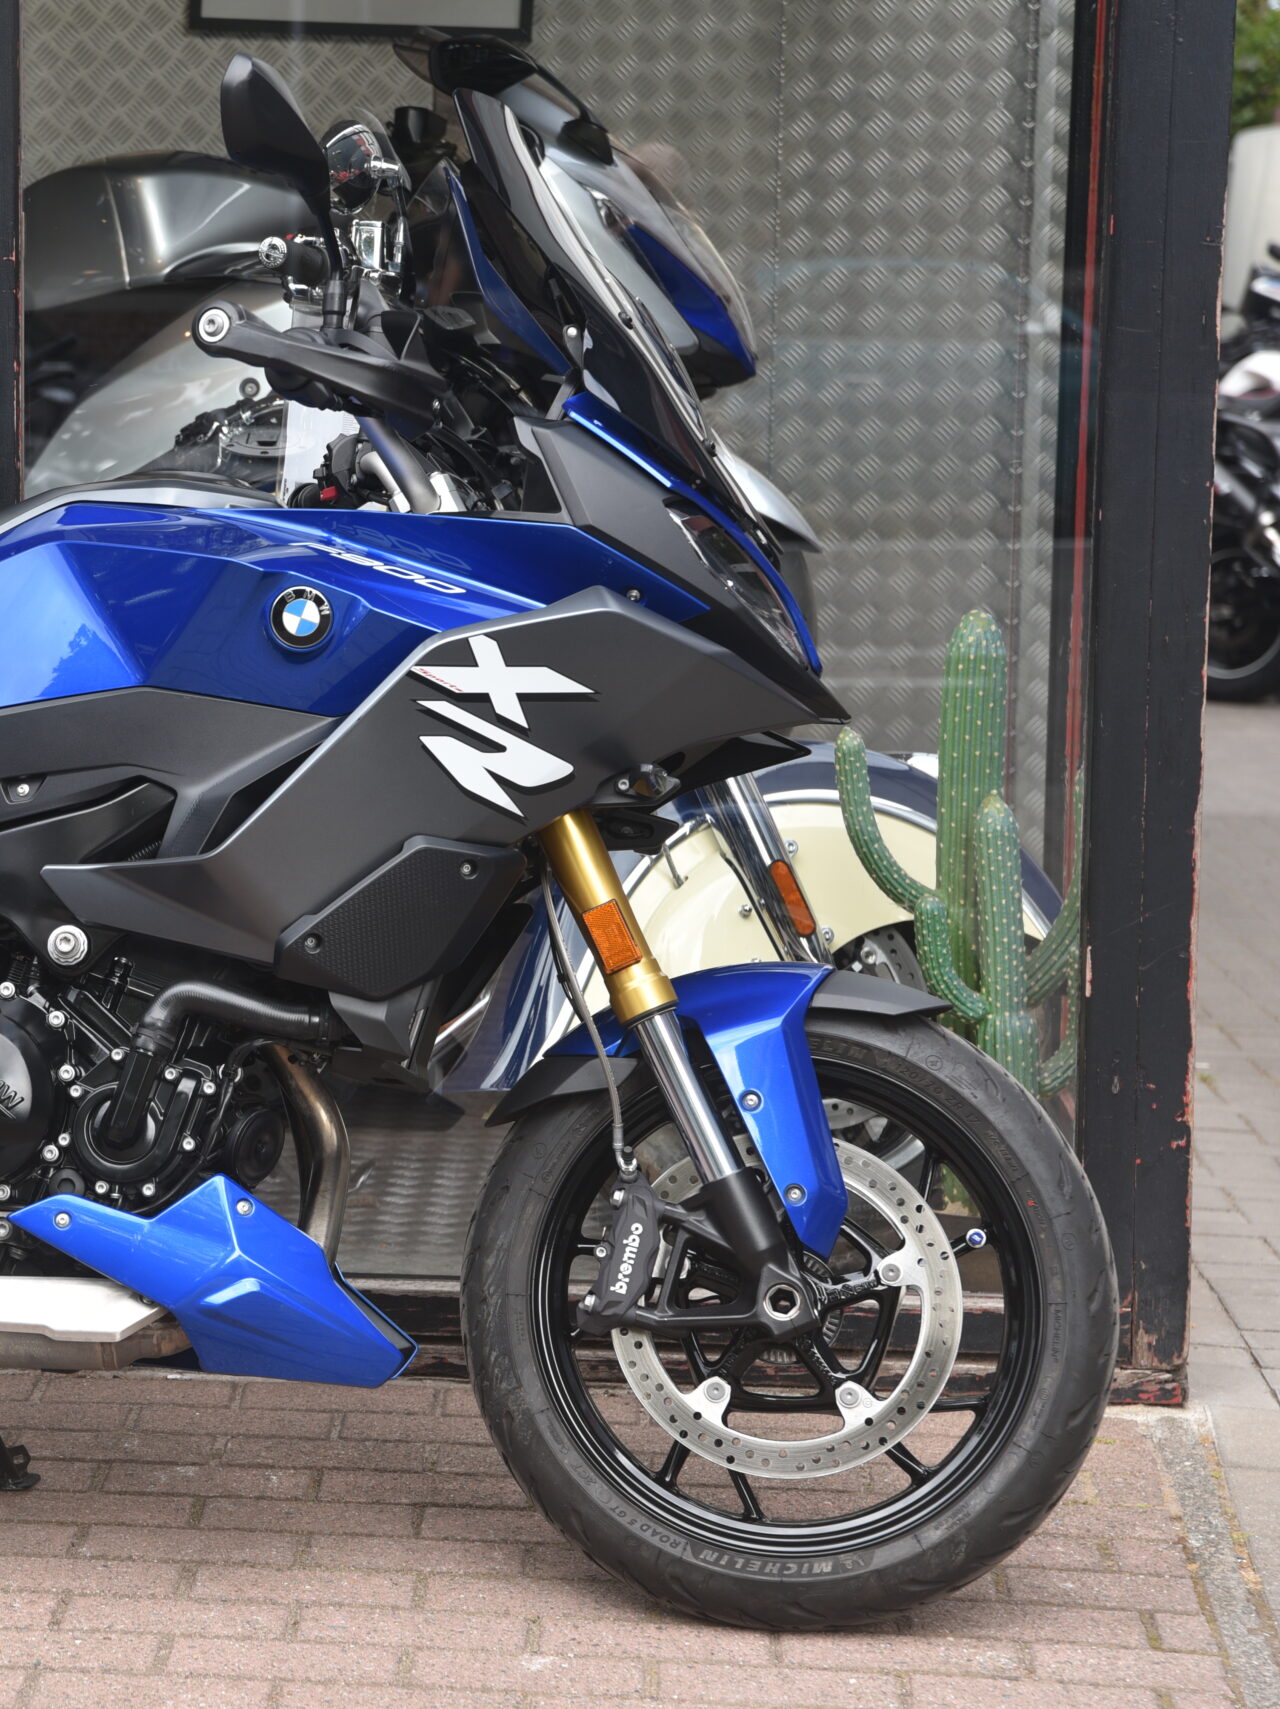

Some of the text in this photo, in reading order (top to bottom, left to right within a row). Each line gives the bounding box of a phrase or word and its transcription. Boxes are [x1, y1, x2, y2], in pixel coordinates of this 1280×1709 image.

[283, 588, 331, 615] BMW
[610, 1222, 643, 1295] brembo
[609, 1504, 627, 1518] GT
[639, 1522, 681, 1549] ROAD
[699, 1549, 833, 1575] MICHELIN
